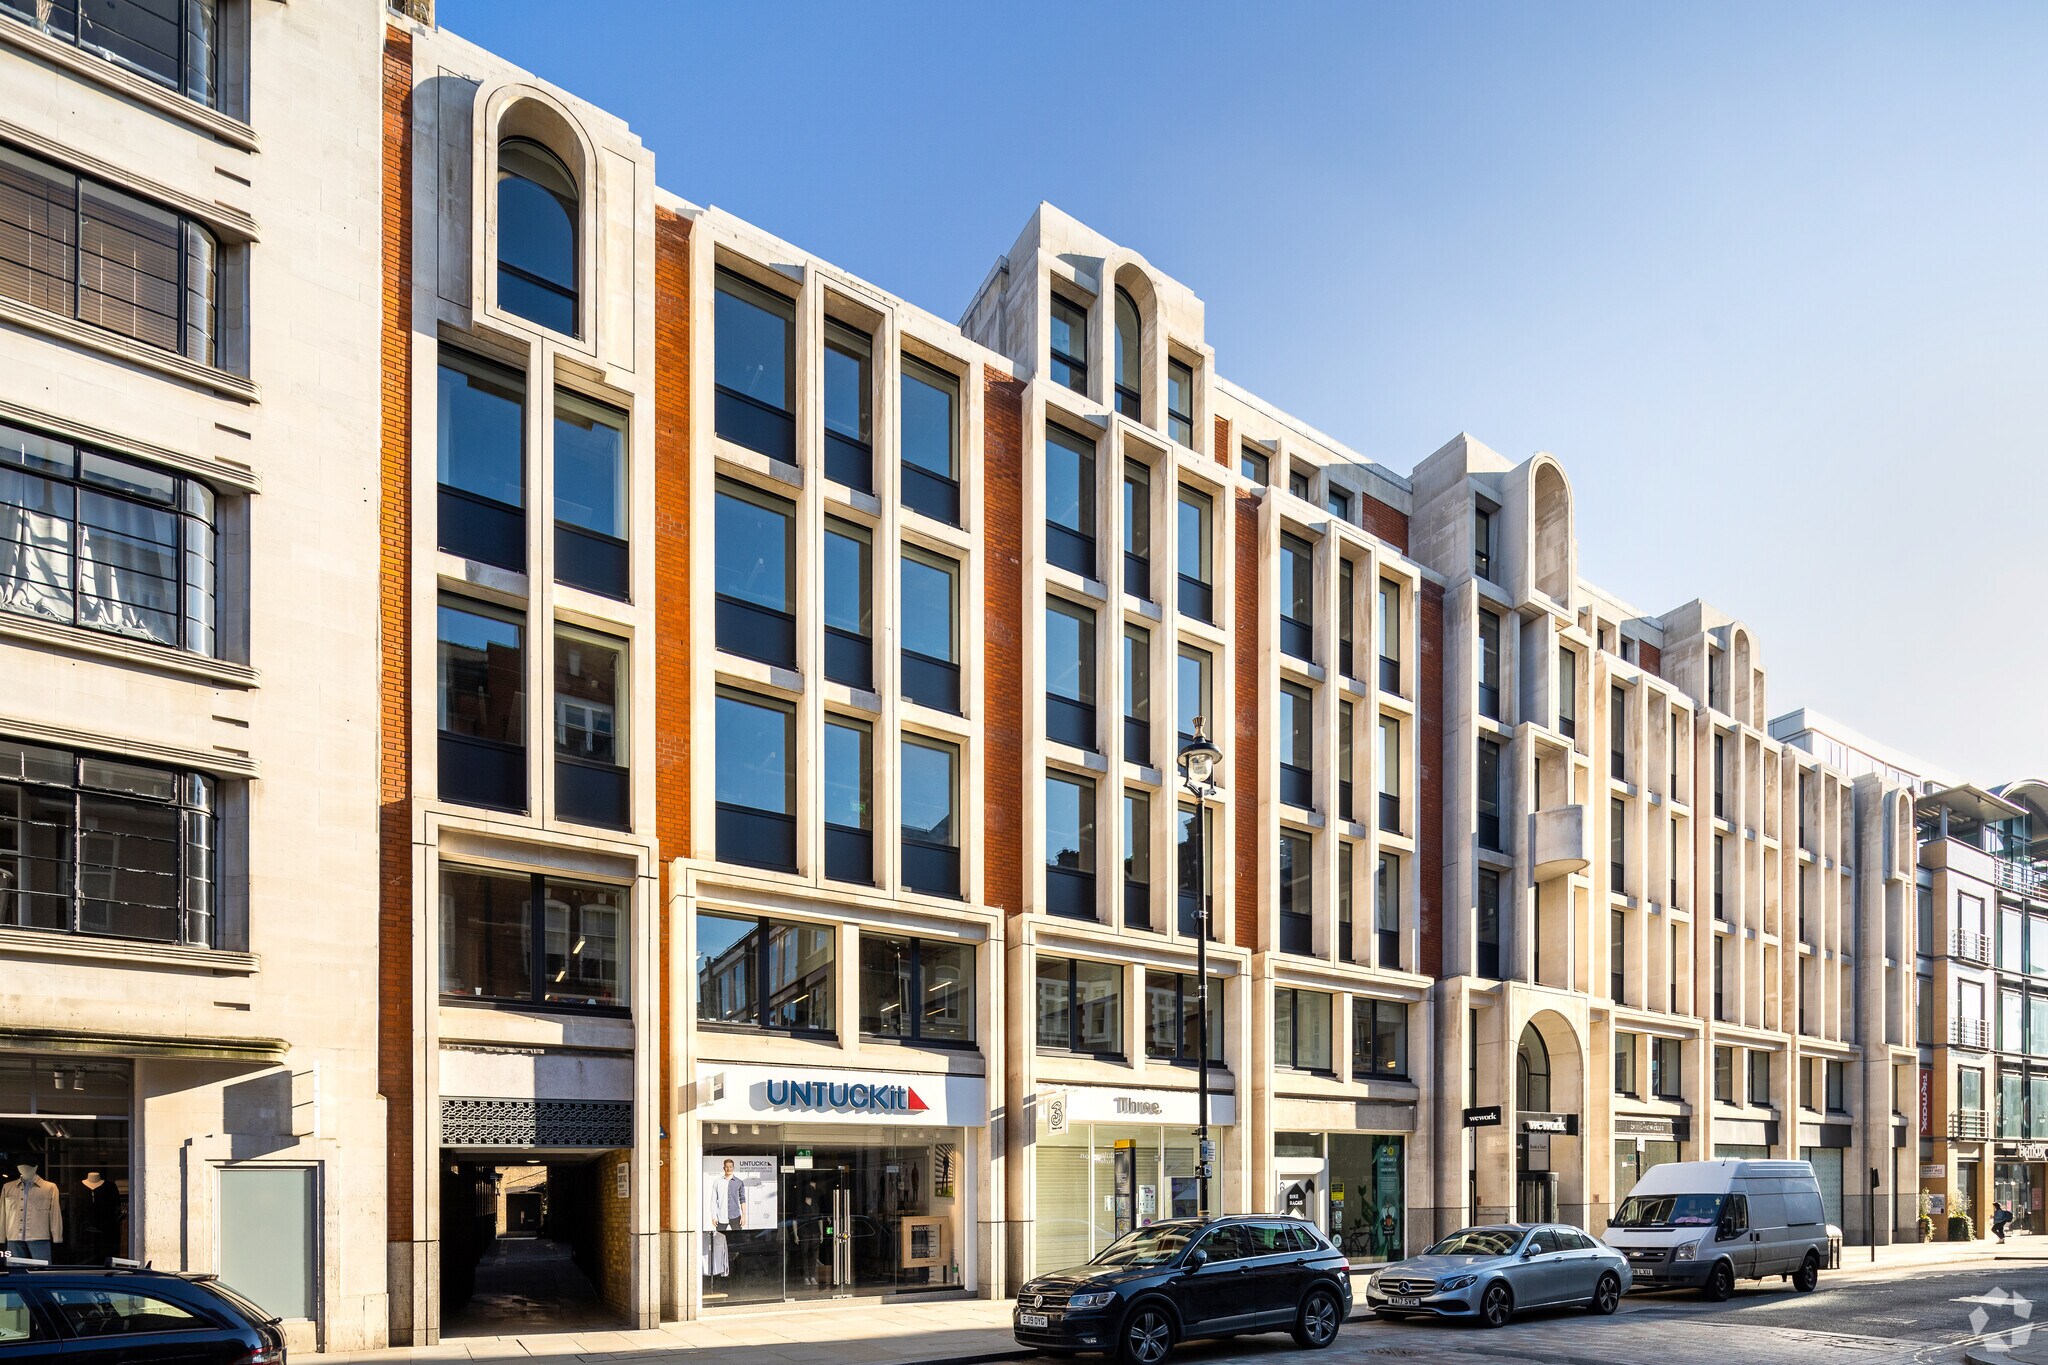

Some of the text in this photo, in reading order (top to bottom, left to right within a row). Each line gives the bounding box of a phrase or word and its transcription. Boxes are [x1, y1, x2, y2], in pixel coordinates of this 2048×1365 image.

[766, 1079, 907, 1109] UNTUCKit
[1469, 1112, 1497, 1122] wework
[1527, 1116, 1567, 1131] wework
